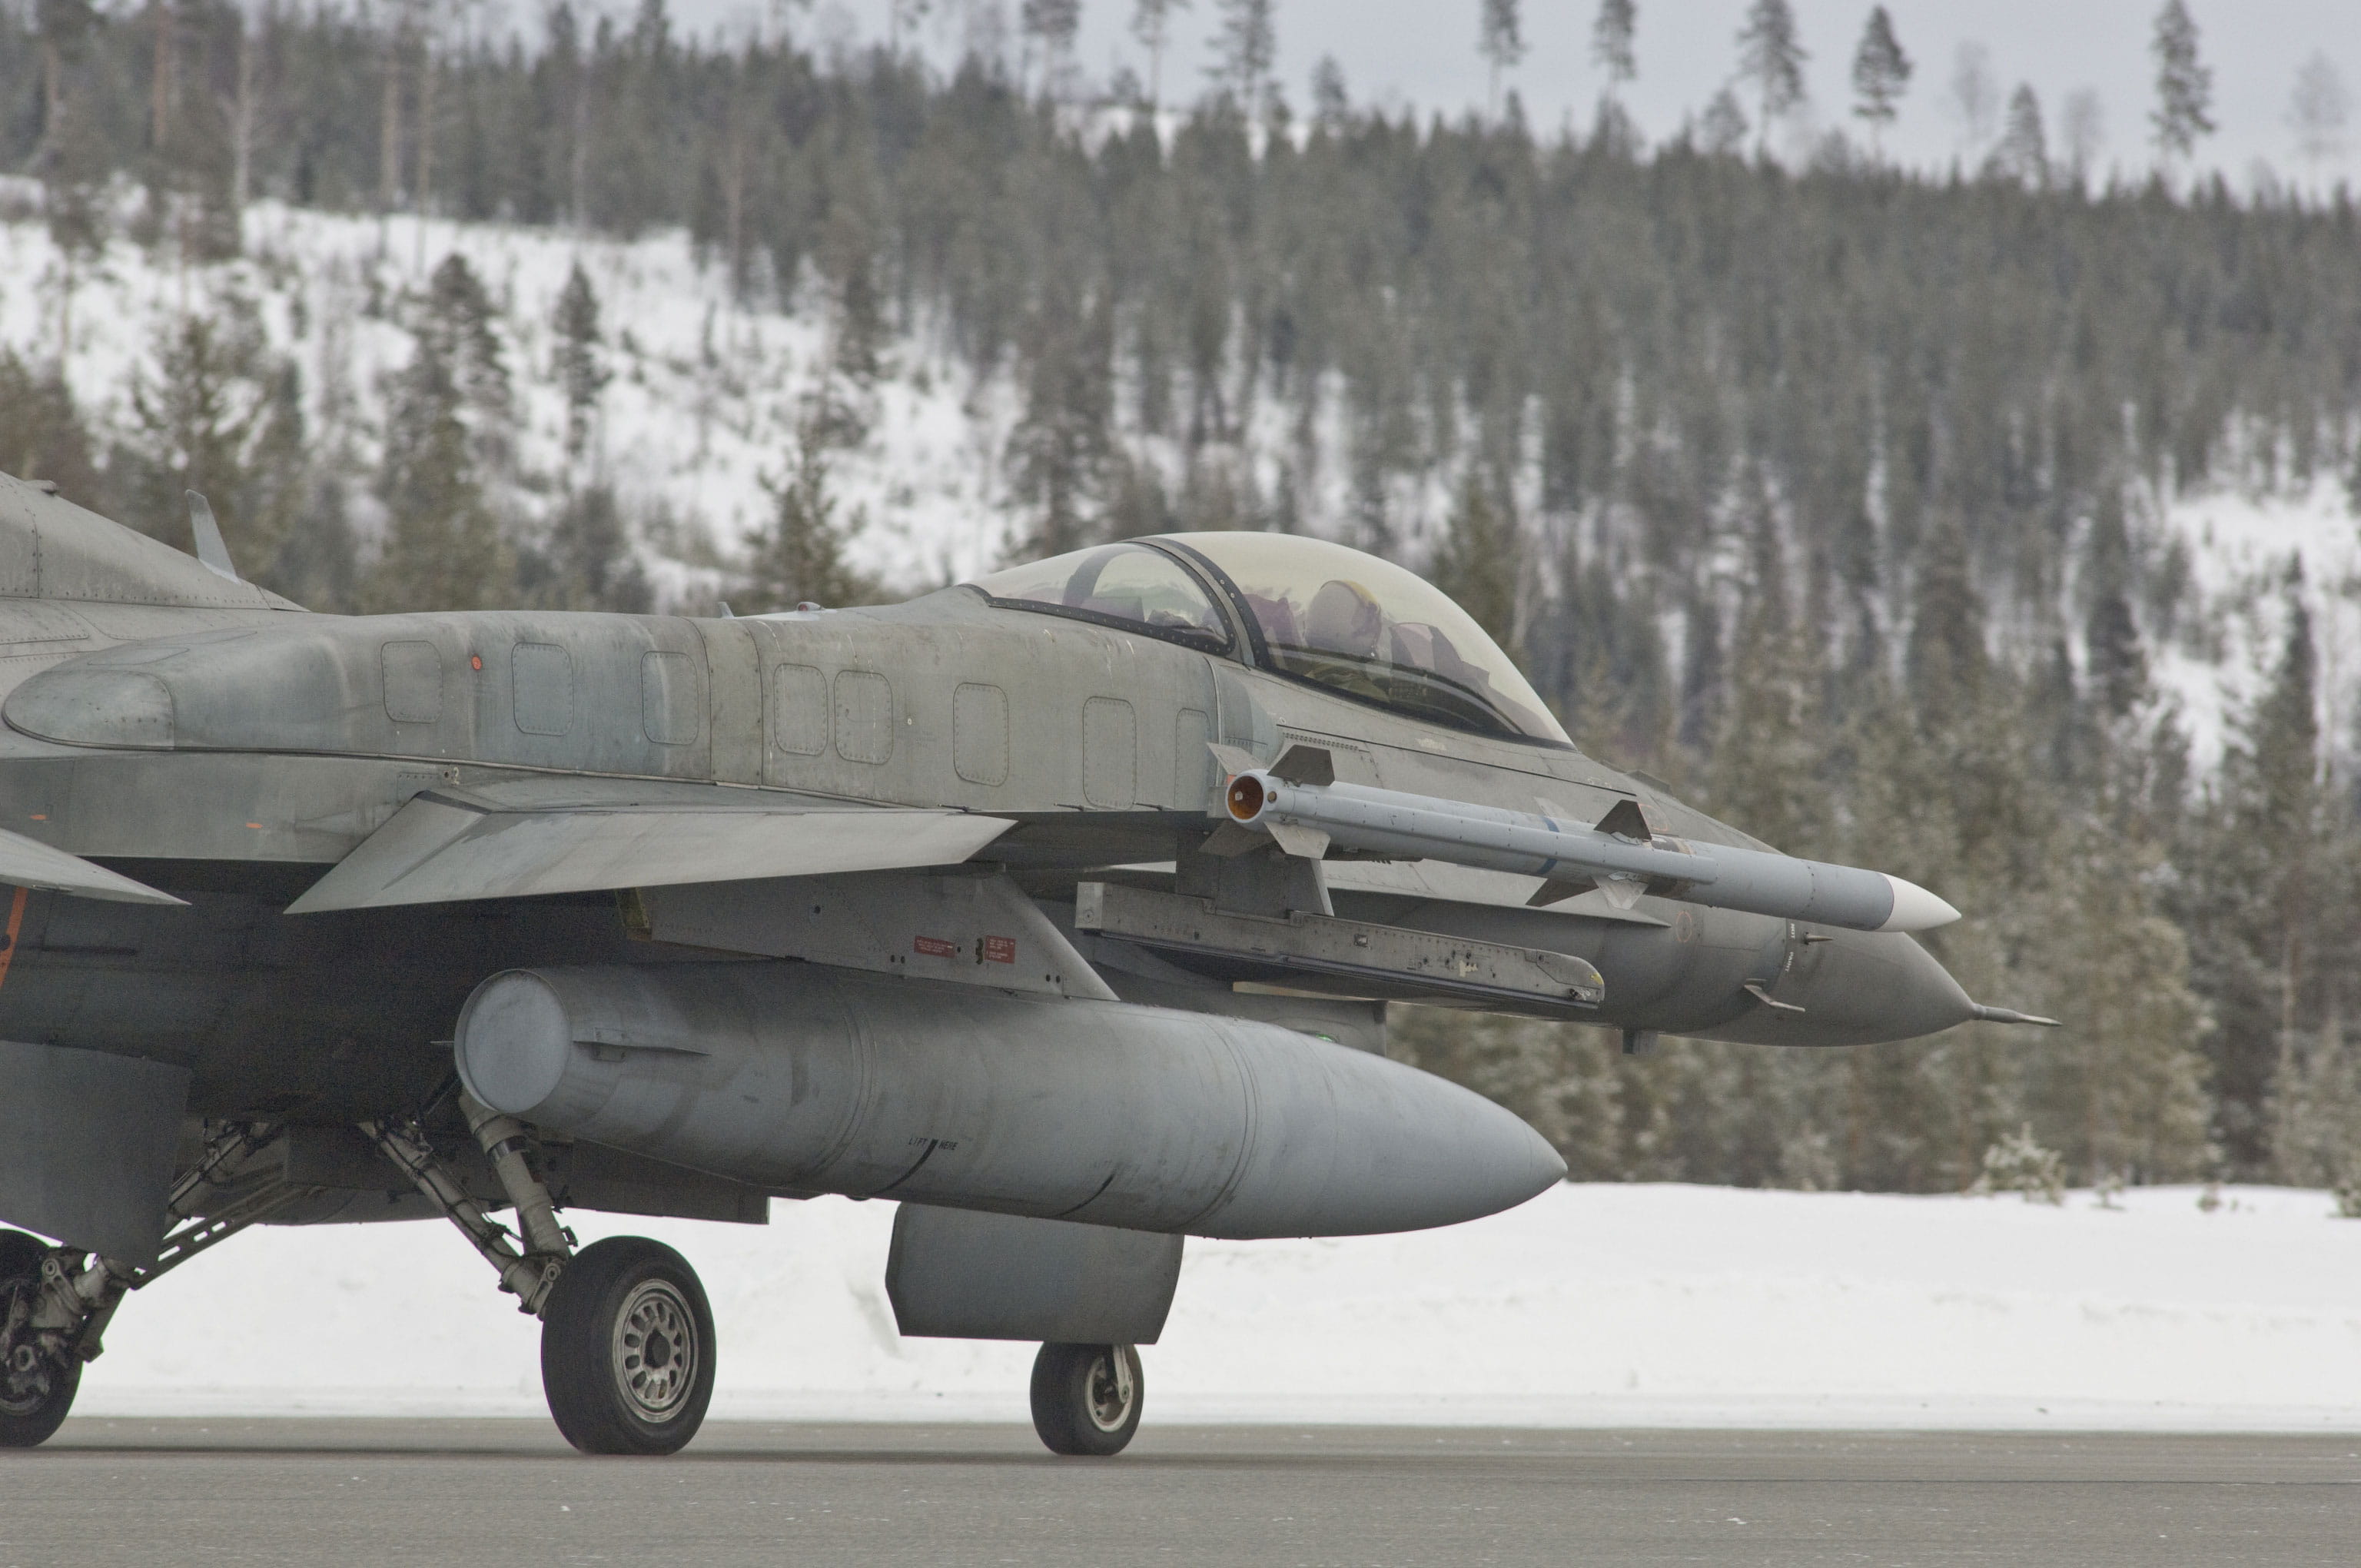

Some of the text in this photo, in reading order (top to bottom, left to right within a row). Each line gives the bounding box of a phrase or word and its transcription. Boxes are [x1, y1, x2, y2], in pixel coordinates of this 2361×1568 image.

[1785, 952, 1794, 972] PAINT
[908, 1137, 958, 1150] LIFT HERE
